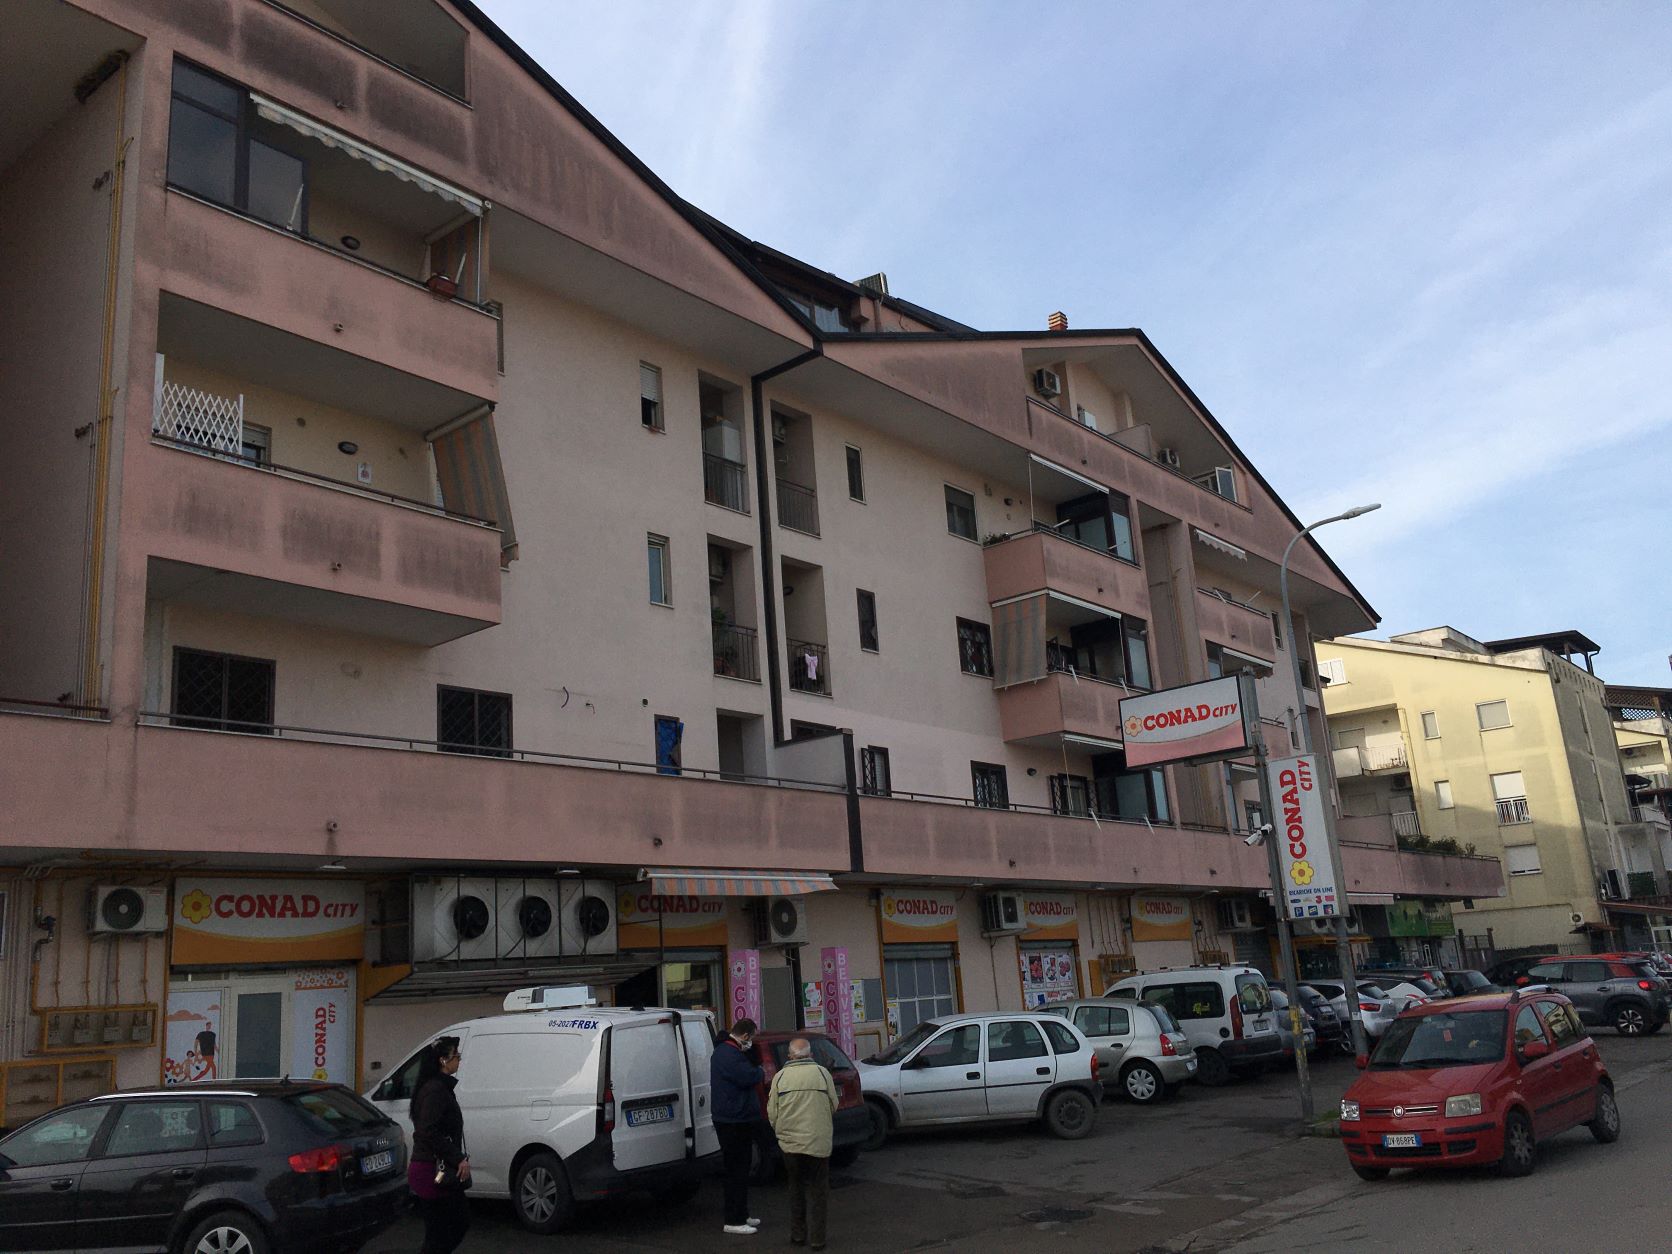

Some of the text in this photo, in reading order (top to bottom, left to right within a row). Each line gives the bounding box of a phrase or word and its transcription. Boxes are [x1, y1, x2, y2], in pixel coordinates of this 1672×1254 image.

[1143, 703, 1238, 731] CONAD CITY
[1279, 760, 1313, 859] CONAD CITY
[214, 894, 360, 919] CONAD CITY
[637, 894, 723, 913] CONAD CITY
[896, 899, 954, 915] CONAD CITY
[1029, 901, 1075, 916] CONAD CITY
[1145, 901, 1172, 915] CONAD
[748, 956, 758, 1019] BENV
[314, 1002, 336, 1068] CONAD CITY
[571, 1019, 600, 1030] FRBX
